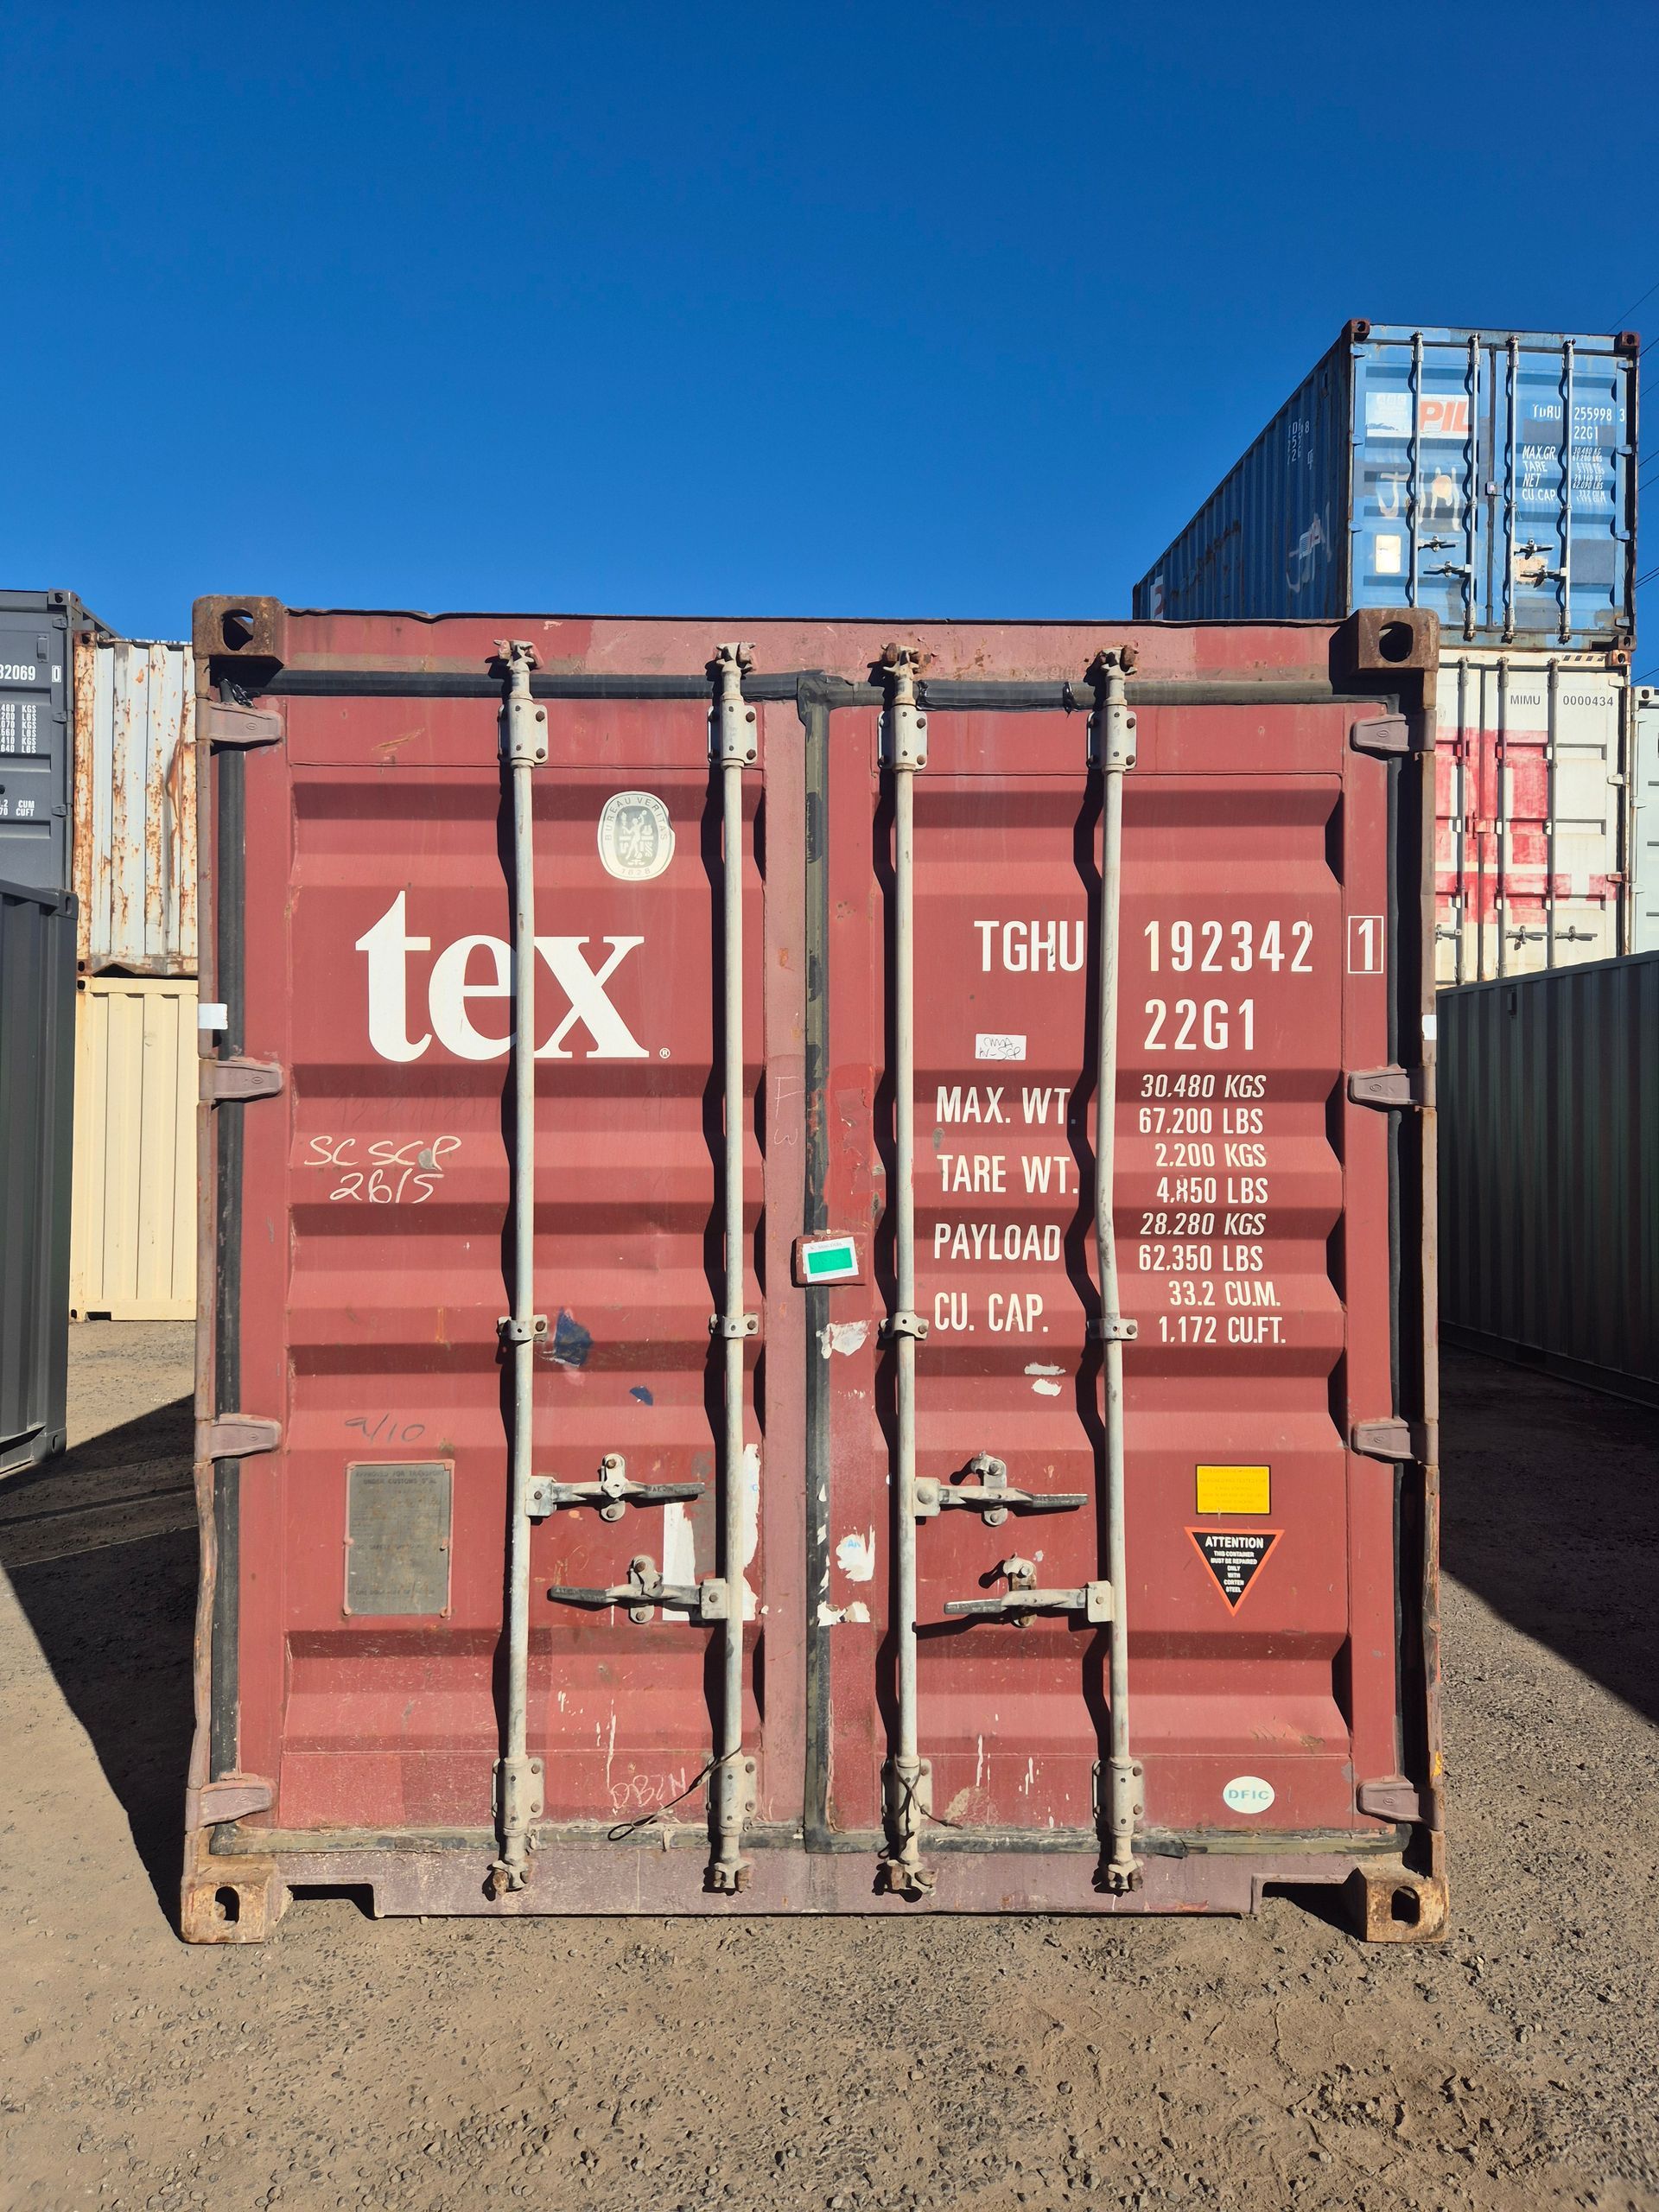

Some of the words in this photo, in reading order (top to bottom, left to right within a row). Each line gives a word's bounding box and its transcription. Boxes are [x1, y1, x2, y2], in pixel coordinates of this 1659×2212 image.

[1420, 401, 1471, 431] PIL
[1573, 407, 1612, 422] 255998
[1619, 408, 1625, 422] 3
[1573, 426, 1599, 440] 22G1
[1523, 461, 1548, 473] TARE
[1522, 473, 1541, 487] NET
[1510, 695, 1541, 705] MIMU
[1562, 695, 1614, 706] 0000434
[22, 721, 37, 729] KGS
[22, 728, 37, 737] LBS
[22, 745, 37, 753] LBS
[16, 807, 35, 817] CUFT
[18, 799, 35, 808] CUM
[605, 797, 632, 841] BUREAU
[636, 797, 668, 841] VERITAS
[974, 920, 1085, 973] TGHU
[1143, 920, 1313, 974] 192342
[355, 890, 650, 1063] tex
[1143, 998, 1255, 1052] 22G1
[1141, 1074, 1216, 1098] 30,480
[1224, 1074, 1267, 1098] KGS
[936, 1086, 1011, 1124] MAX.
[1021, 1087, 1077, 1125] WT.
[1139, 1107, 1212, 1134] 67,200
[1223, 1108, 1263, 1135] LBS
[1224, 1143, 1268, 1167] KGS
[936, 1154, 1007, 1192] TARE
[1021, 1155, 1078, 1194] WT.
[1227, 1177, 1268, 1204] LBS
[934, 1223, 1061, 1262] PAYLOAD
[1140, 1212, 1215, 1236] 28,280
[1224, 1212, 1267, 1236] KGS
[1139, 1244, 1212, 1271] 62,350
[1223, 1245, 1263, 1272] LBS
[1168, 1281, 1216, 1306] 33.2
[1224, 1281, 1281, 1306] CU.M.
[934, 1292, 975, 1332] CU.
[988, 1293, 1049, 1332] CAP.
[1159, 1316, 1217, 1343] 1,172
[1228, 1316, 1287, 1344] CU.FT.
[1205, 1535, 1264, 1549] ATTENTION
[1228, 1789, 1270, 1801] DFIC
